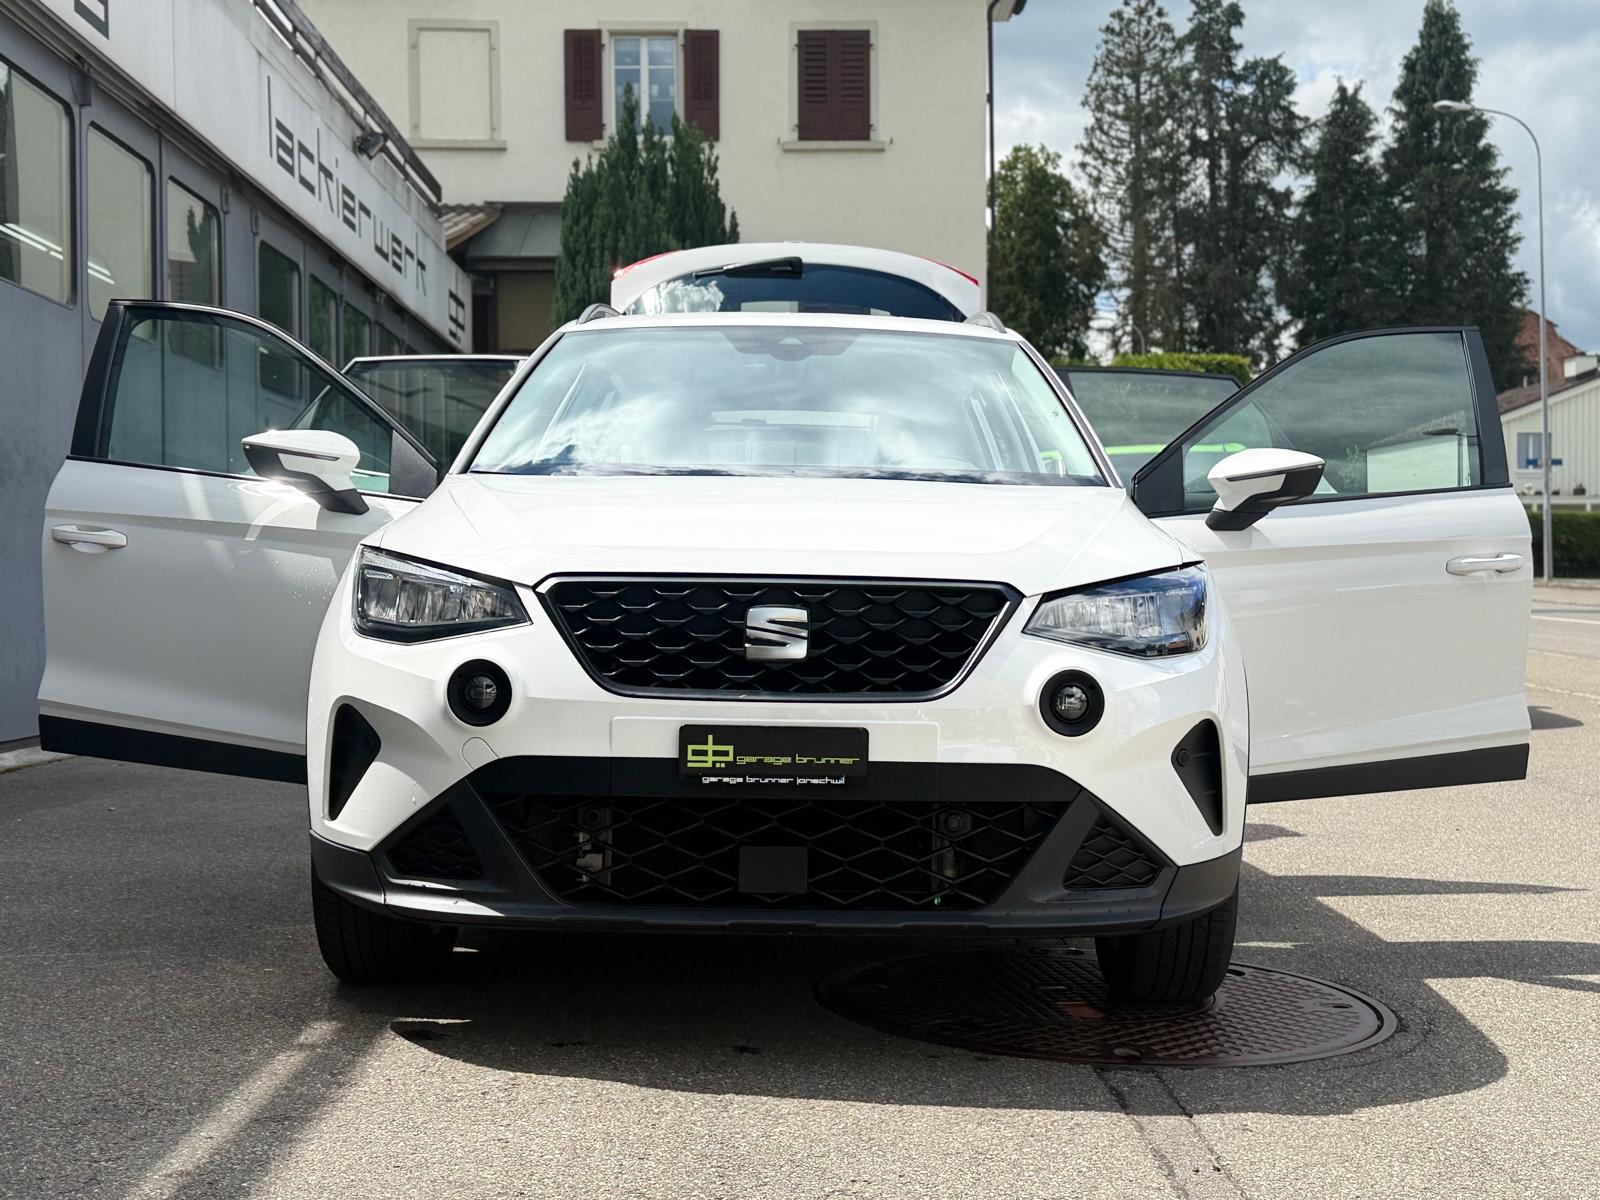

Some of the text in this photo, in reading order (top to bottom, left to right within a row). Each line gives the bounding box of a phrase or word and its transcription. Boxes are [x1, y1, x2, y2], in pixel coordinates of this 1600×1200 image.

[267, 75, 427, 297] lackierwerk
[736, 753, 860, 765] garage brunner
[702, 776, 743, 784] garage
[746, 775, 794, 784] brunner
